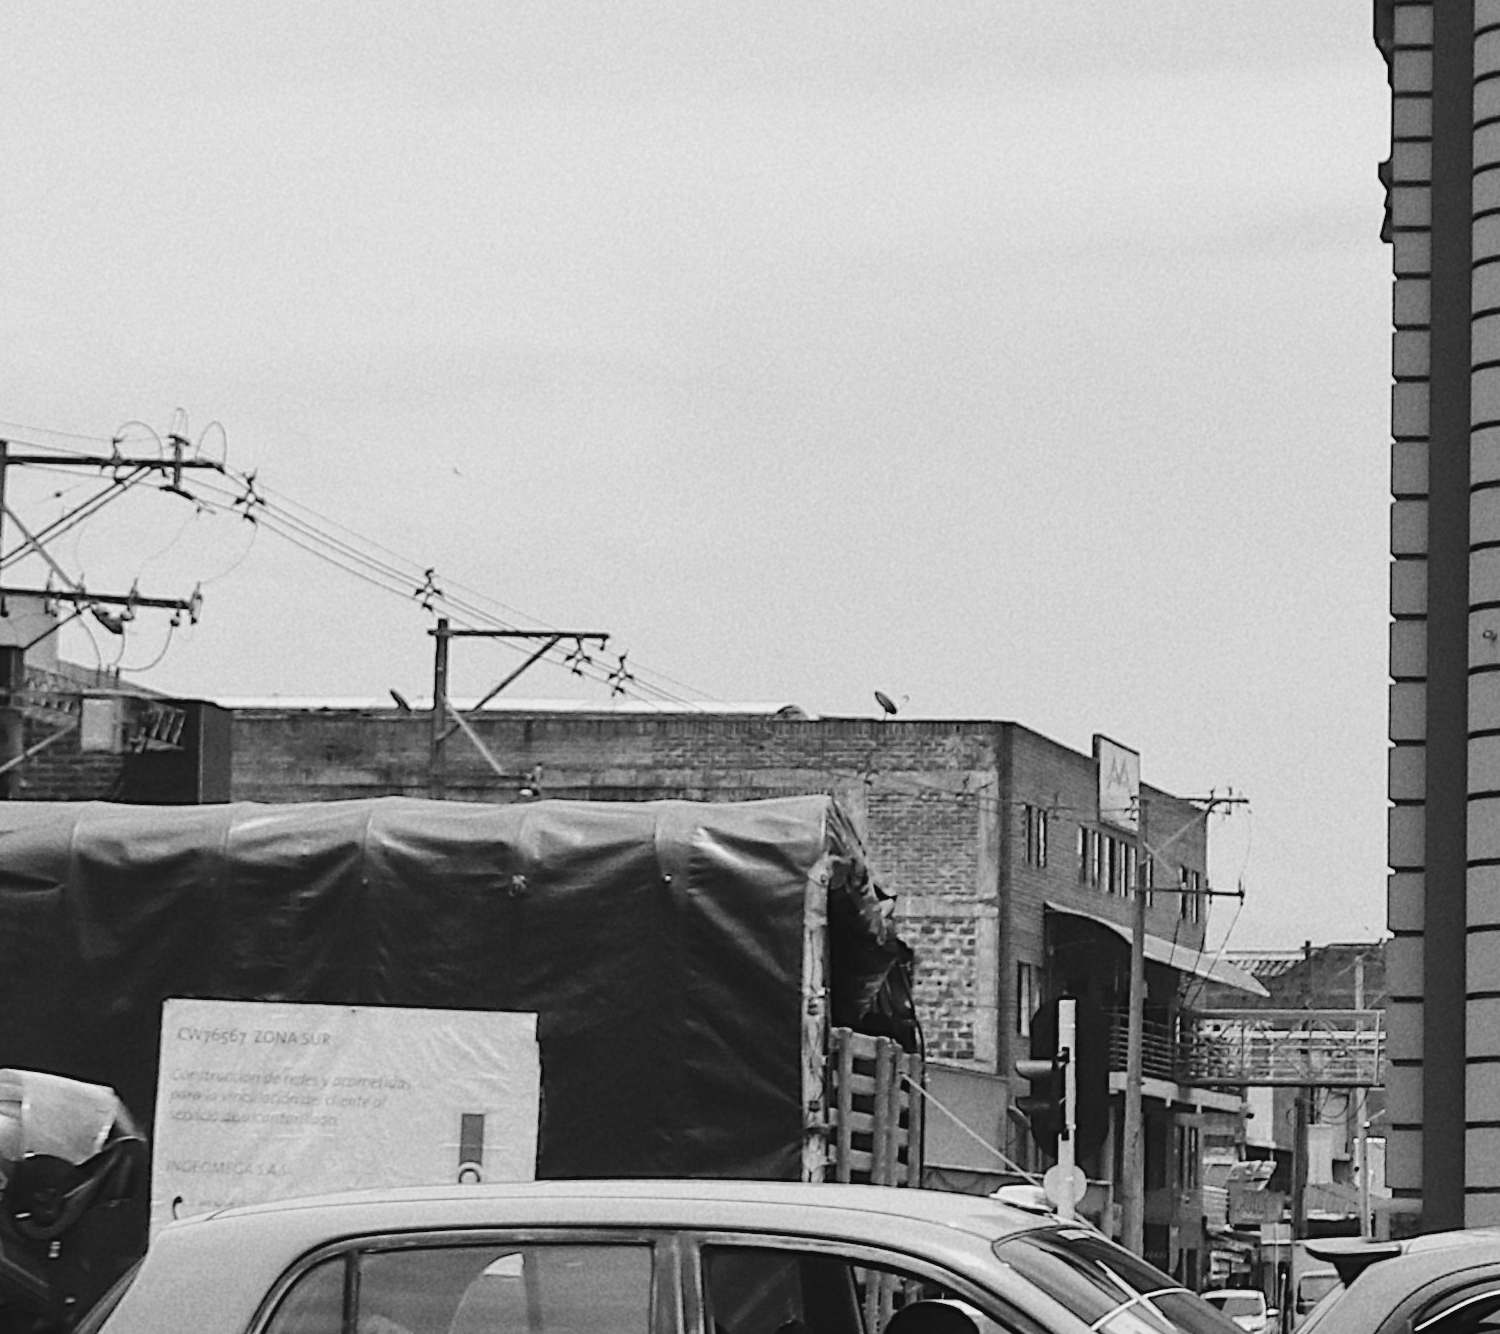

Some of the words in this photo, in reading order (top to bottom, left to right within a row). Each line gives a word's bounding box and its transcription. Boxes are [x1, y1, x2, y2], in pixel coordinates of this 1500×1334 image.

[177, 1027, 247, 1046] CW76567
[254, 1029, 297, 1045] ZONA
[302, 1031, 332, 1045] SUR
